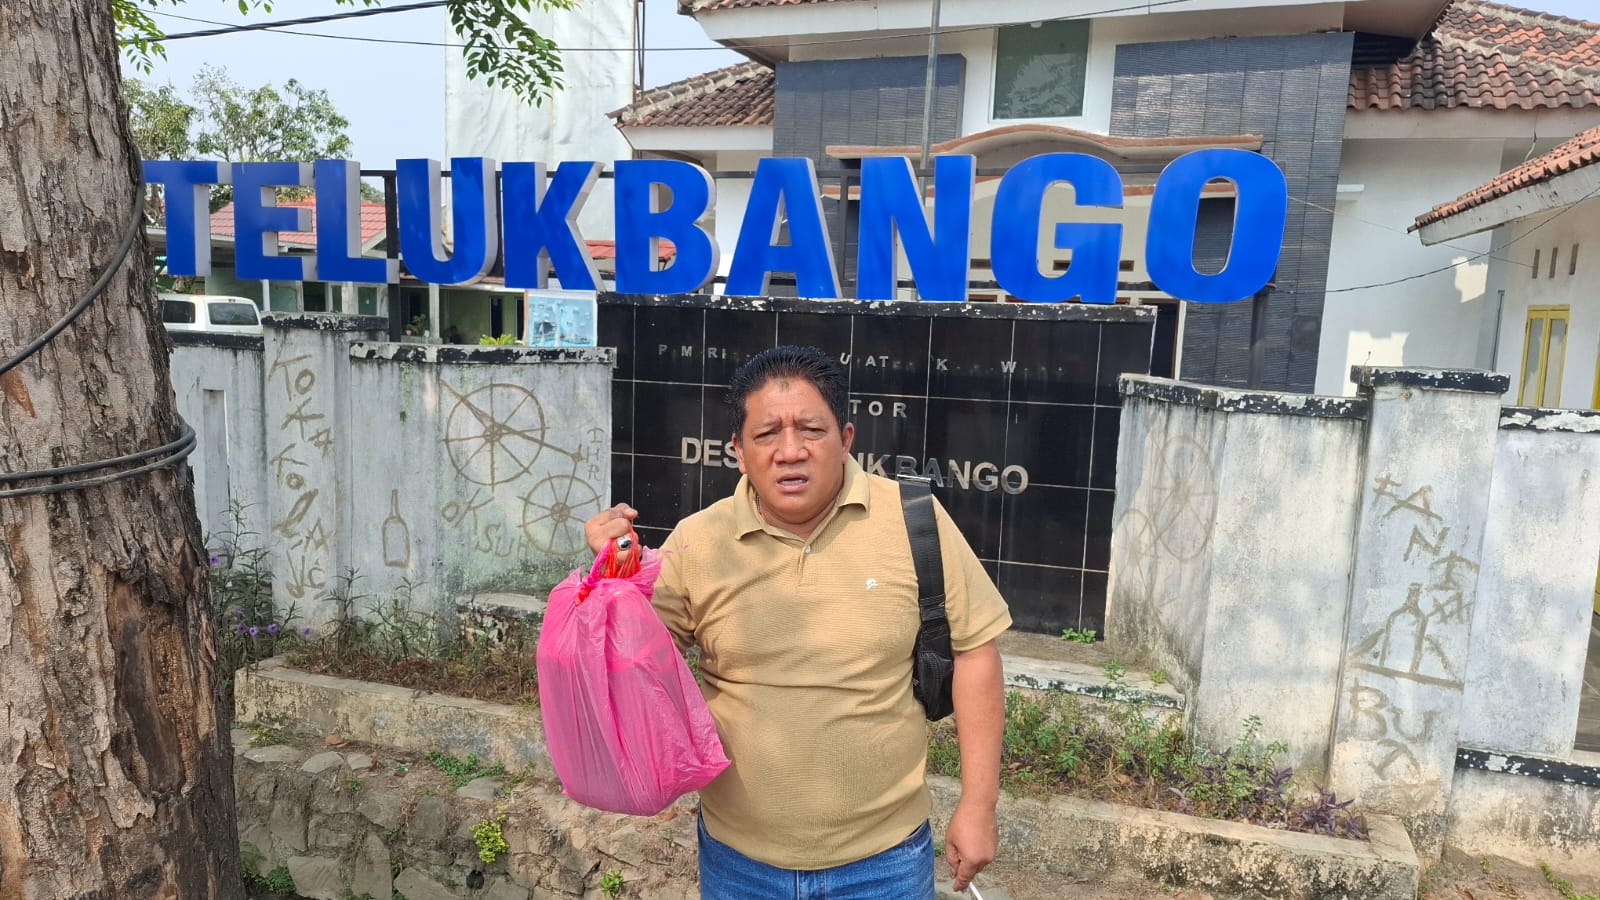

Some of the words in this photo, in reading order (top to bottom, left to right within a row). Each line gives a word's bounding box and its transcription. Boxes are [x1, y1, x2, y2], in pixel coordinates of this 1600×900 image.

[142, 148, 1288, 304] TELUKBANGO
[848, 399, 908, 419] TOR
[681, 436, 739, 469] DES
[857, 452, 1029, 495] KBANGO
